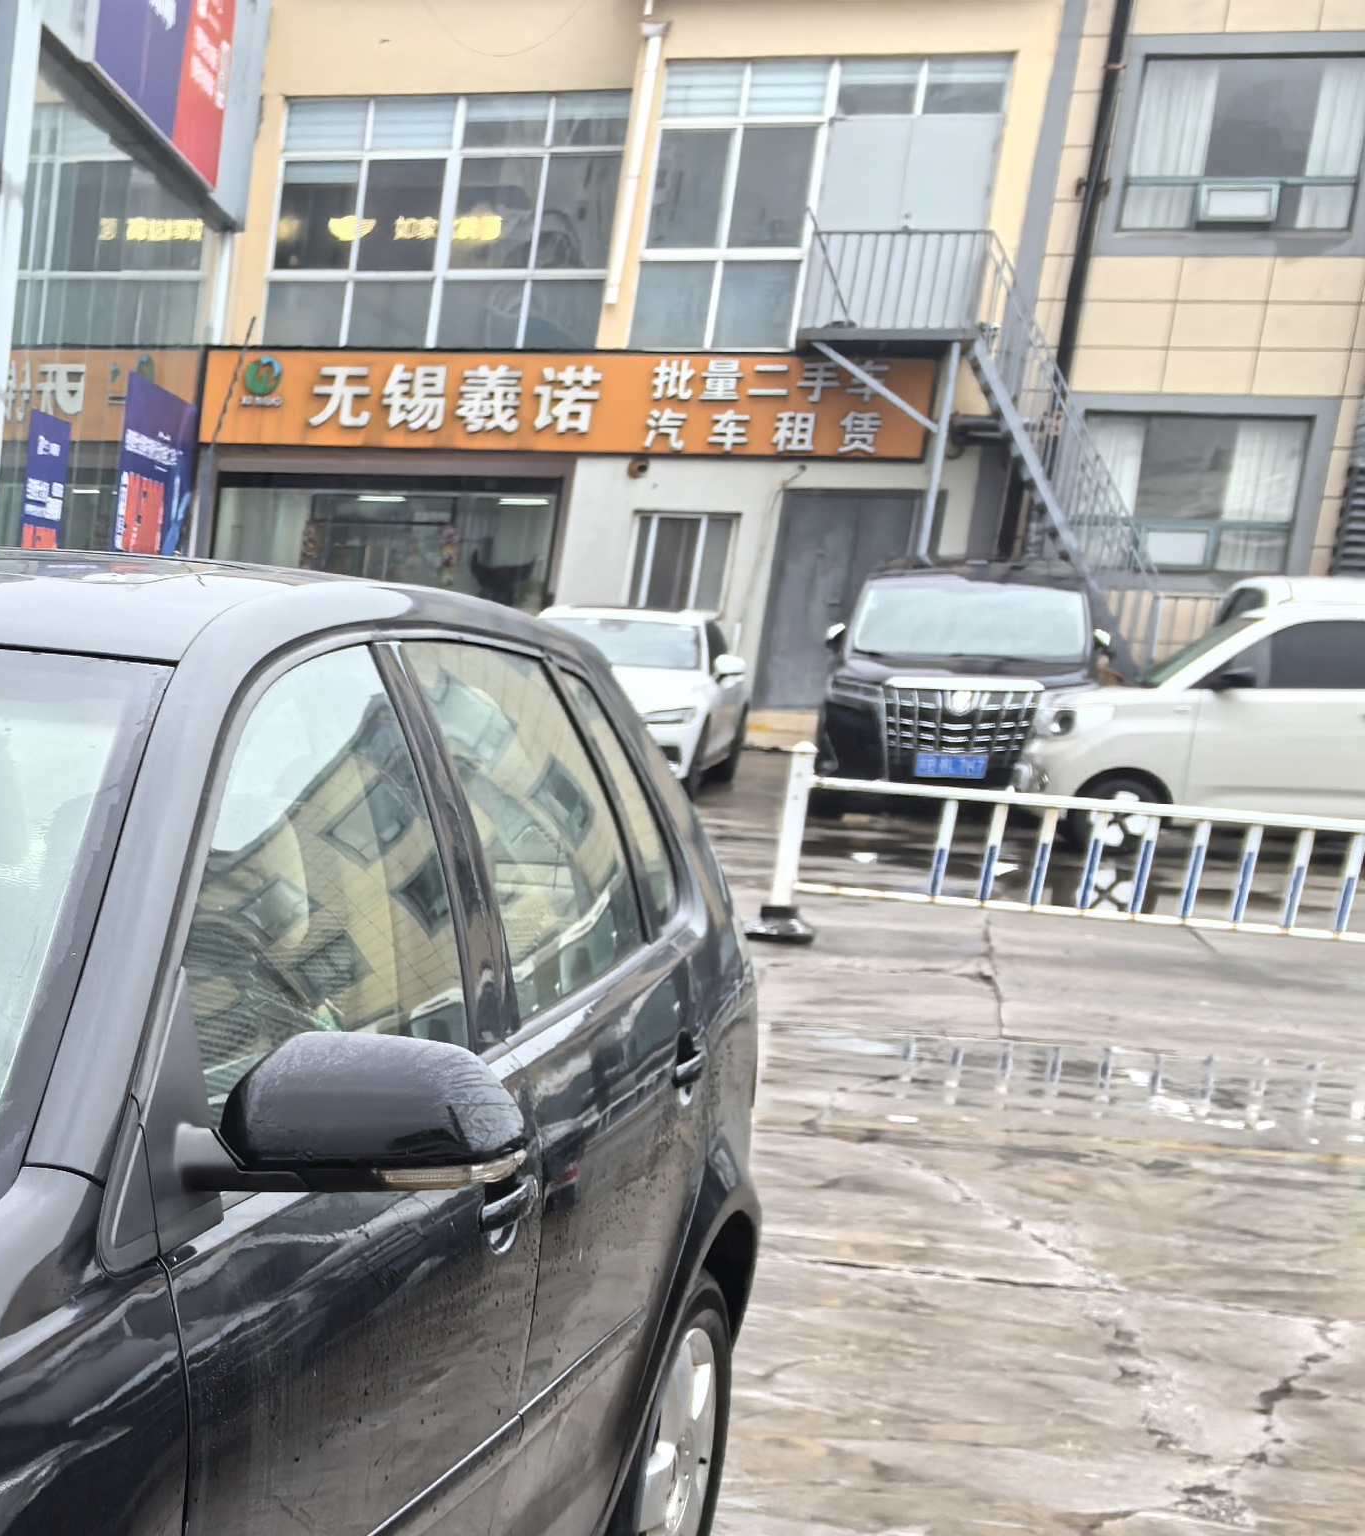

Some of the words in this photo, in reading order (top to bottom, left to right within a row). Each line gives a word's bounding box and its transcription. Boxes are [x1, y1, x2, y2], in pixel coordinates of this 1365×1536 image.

[651, 359, 890, 403] 批量二手车
[642, 408, 883, 454] 汽车租赁
